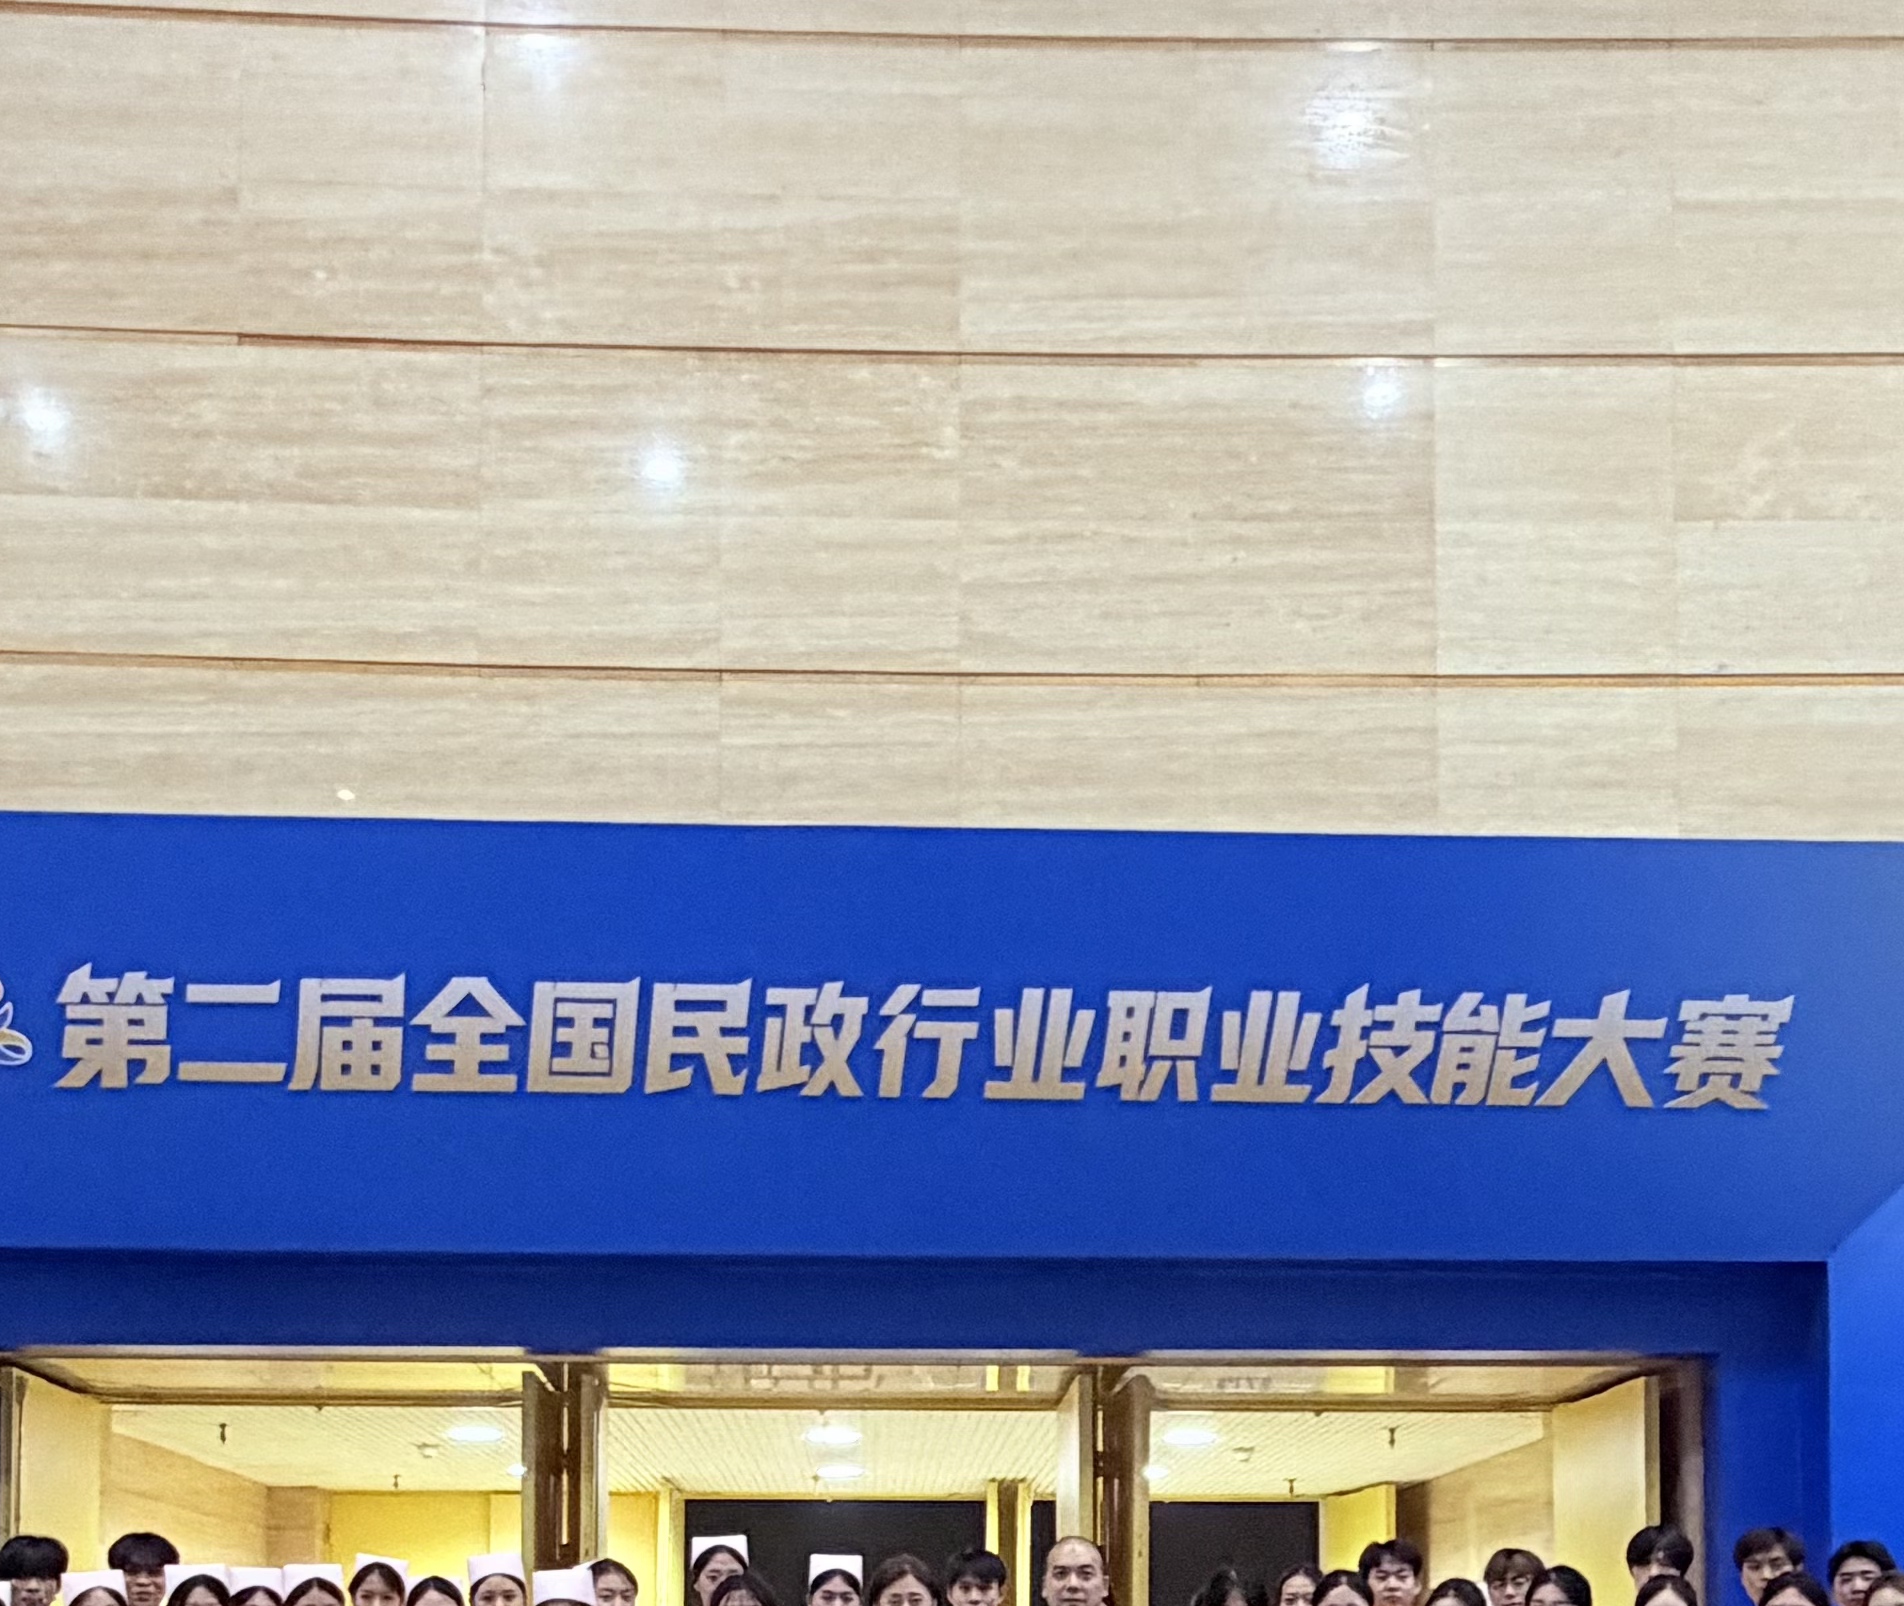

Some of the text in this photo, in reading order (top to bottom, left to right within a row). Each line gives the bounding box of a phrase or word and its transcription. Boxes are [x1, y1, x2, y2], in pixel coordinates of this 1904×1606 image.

[52, 962, 1795, 1112] 第二届全国民政行业职业技能大赛
